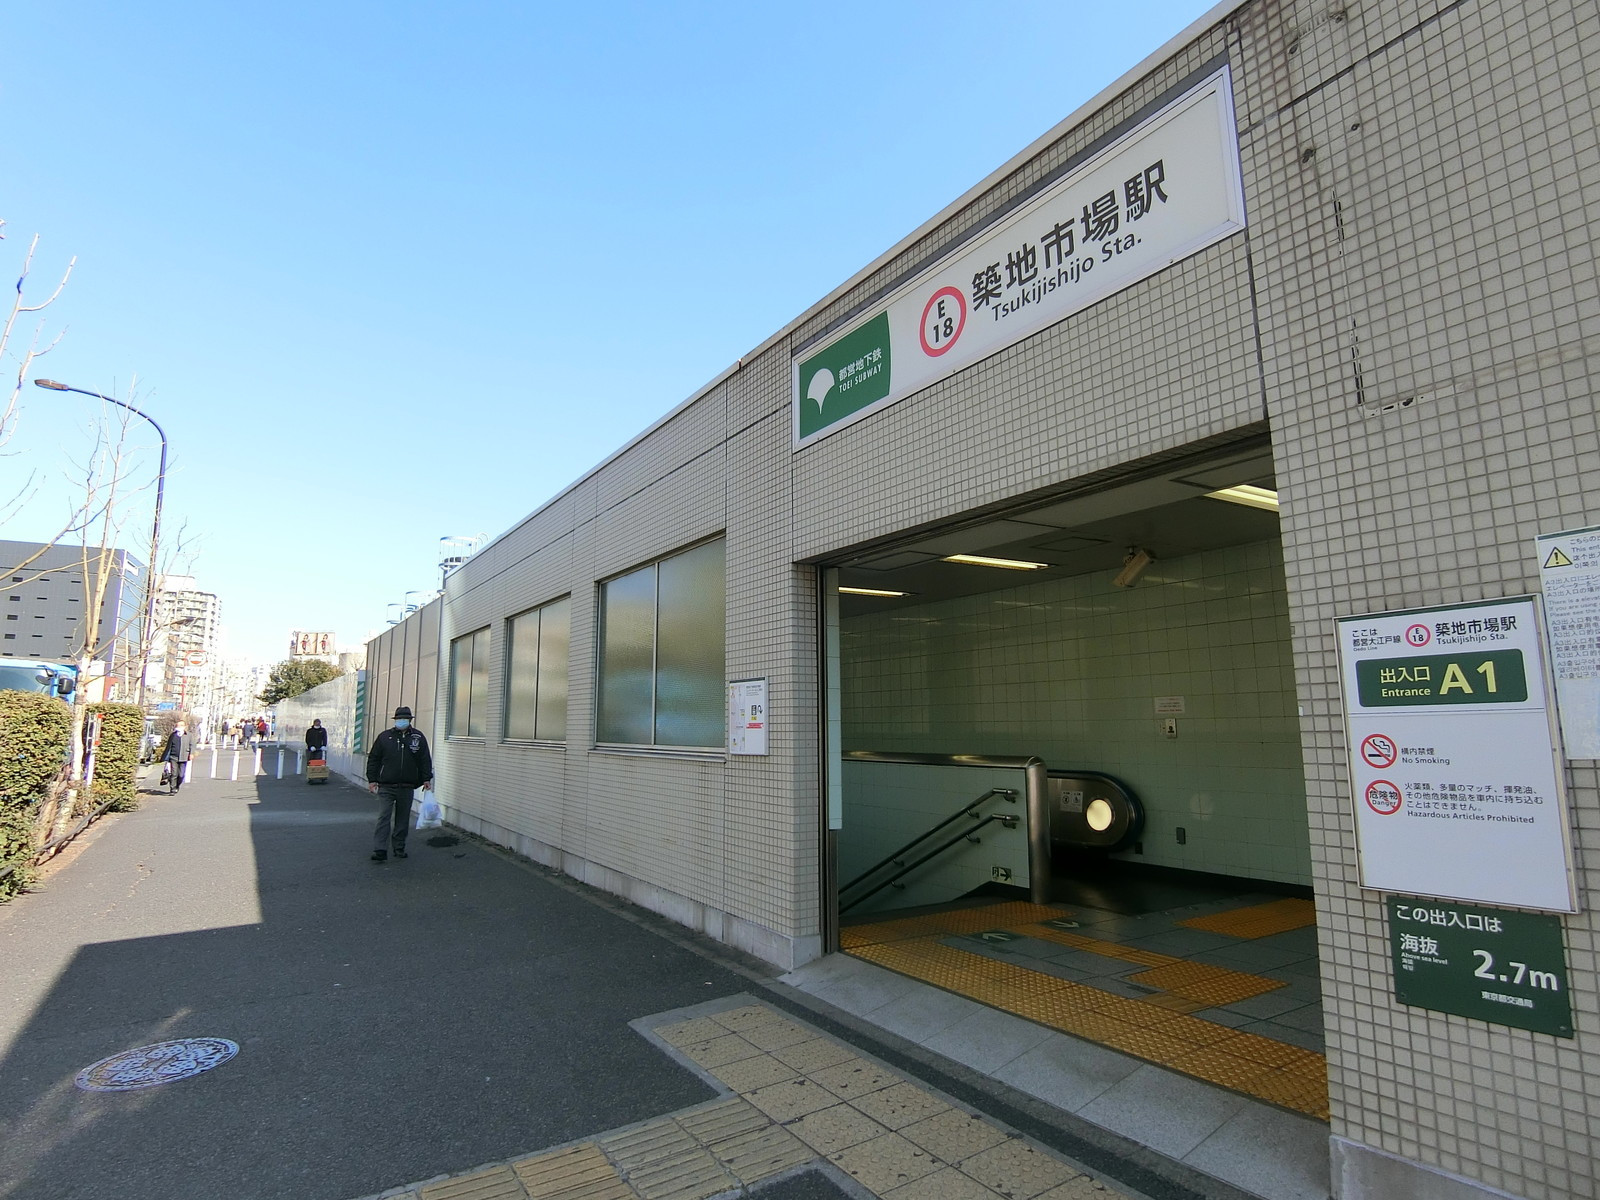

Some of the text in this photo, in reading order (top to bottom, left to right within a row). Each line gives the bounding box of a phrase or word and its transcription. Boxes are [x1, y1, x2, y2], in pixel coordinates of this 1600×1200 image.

[971, 158, 1169, 312] 築地市場駅
[991, 233, 1142, 322] Tsukijishijo Sta.
[937, 300, 946, 319] E
[933, 317, 954, 343] 18
[838, 347, 882, 382] 都営地下鉄
[839, 363, 882, 393] TOEI SUBWAY
[1352, 628, 1378, 638] ここは
[1435, 615, 1518, 637] 築地市場駅
[1352, 635, 1402, 647] 都営大江戸線
[1412, 634, 1424, 642] 18
[1436, 632, 1509, 646] Tsukijishijo Sta.
[1380, 660, 1497, 695] 出入口 A1
[1382, 687, 1431, 698] Entrance
[1401, 747, 1435, 756] 構内禁煙
[1415, 757, 1450, 766] Smoking
[1369, 790, 1398, 800] 危険物
[1406, 792, 1543, 805] その他危険物品を車内に持ち込む
[1406, 801, 1482, 812] ことはできません。
[1407, 810, 1535, 824] Hazardous Articles Prohibited
[1396, 904, 1503, 933] この出入口は
[1400, 932, 1439, 956] 海抜
[1401, 952, 1420, 960] Above
[1433, 957, 1448, 965] level
[1472, 949, 1559, 991] 2.7m
